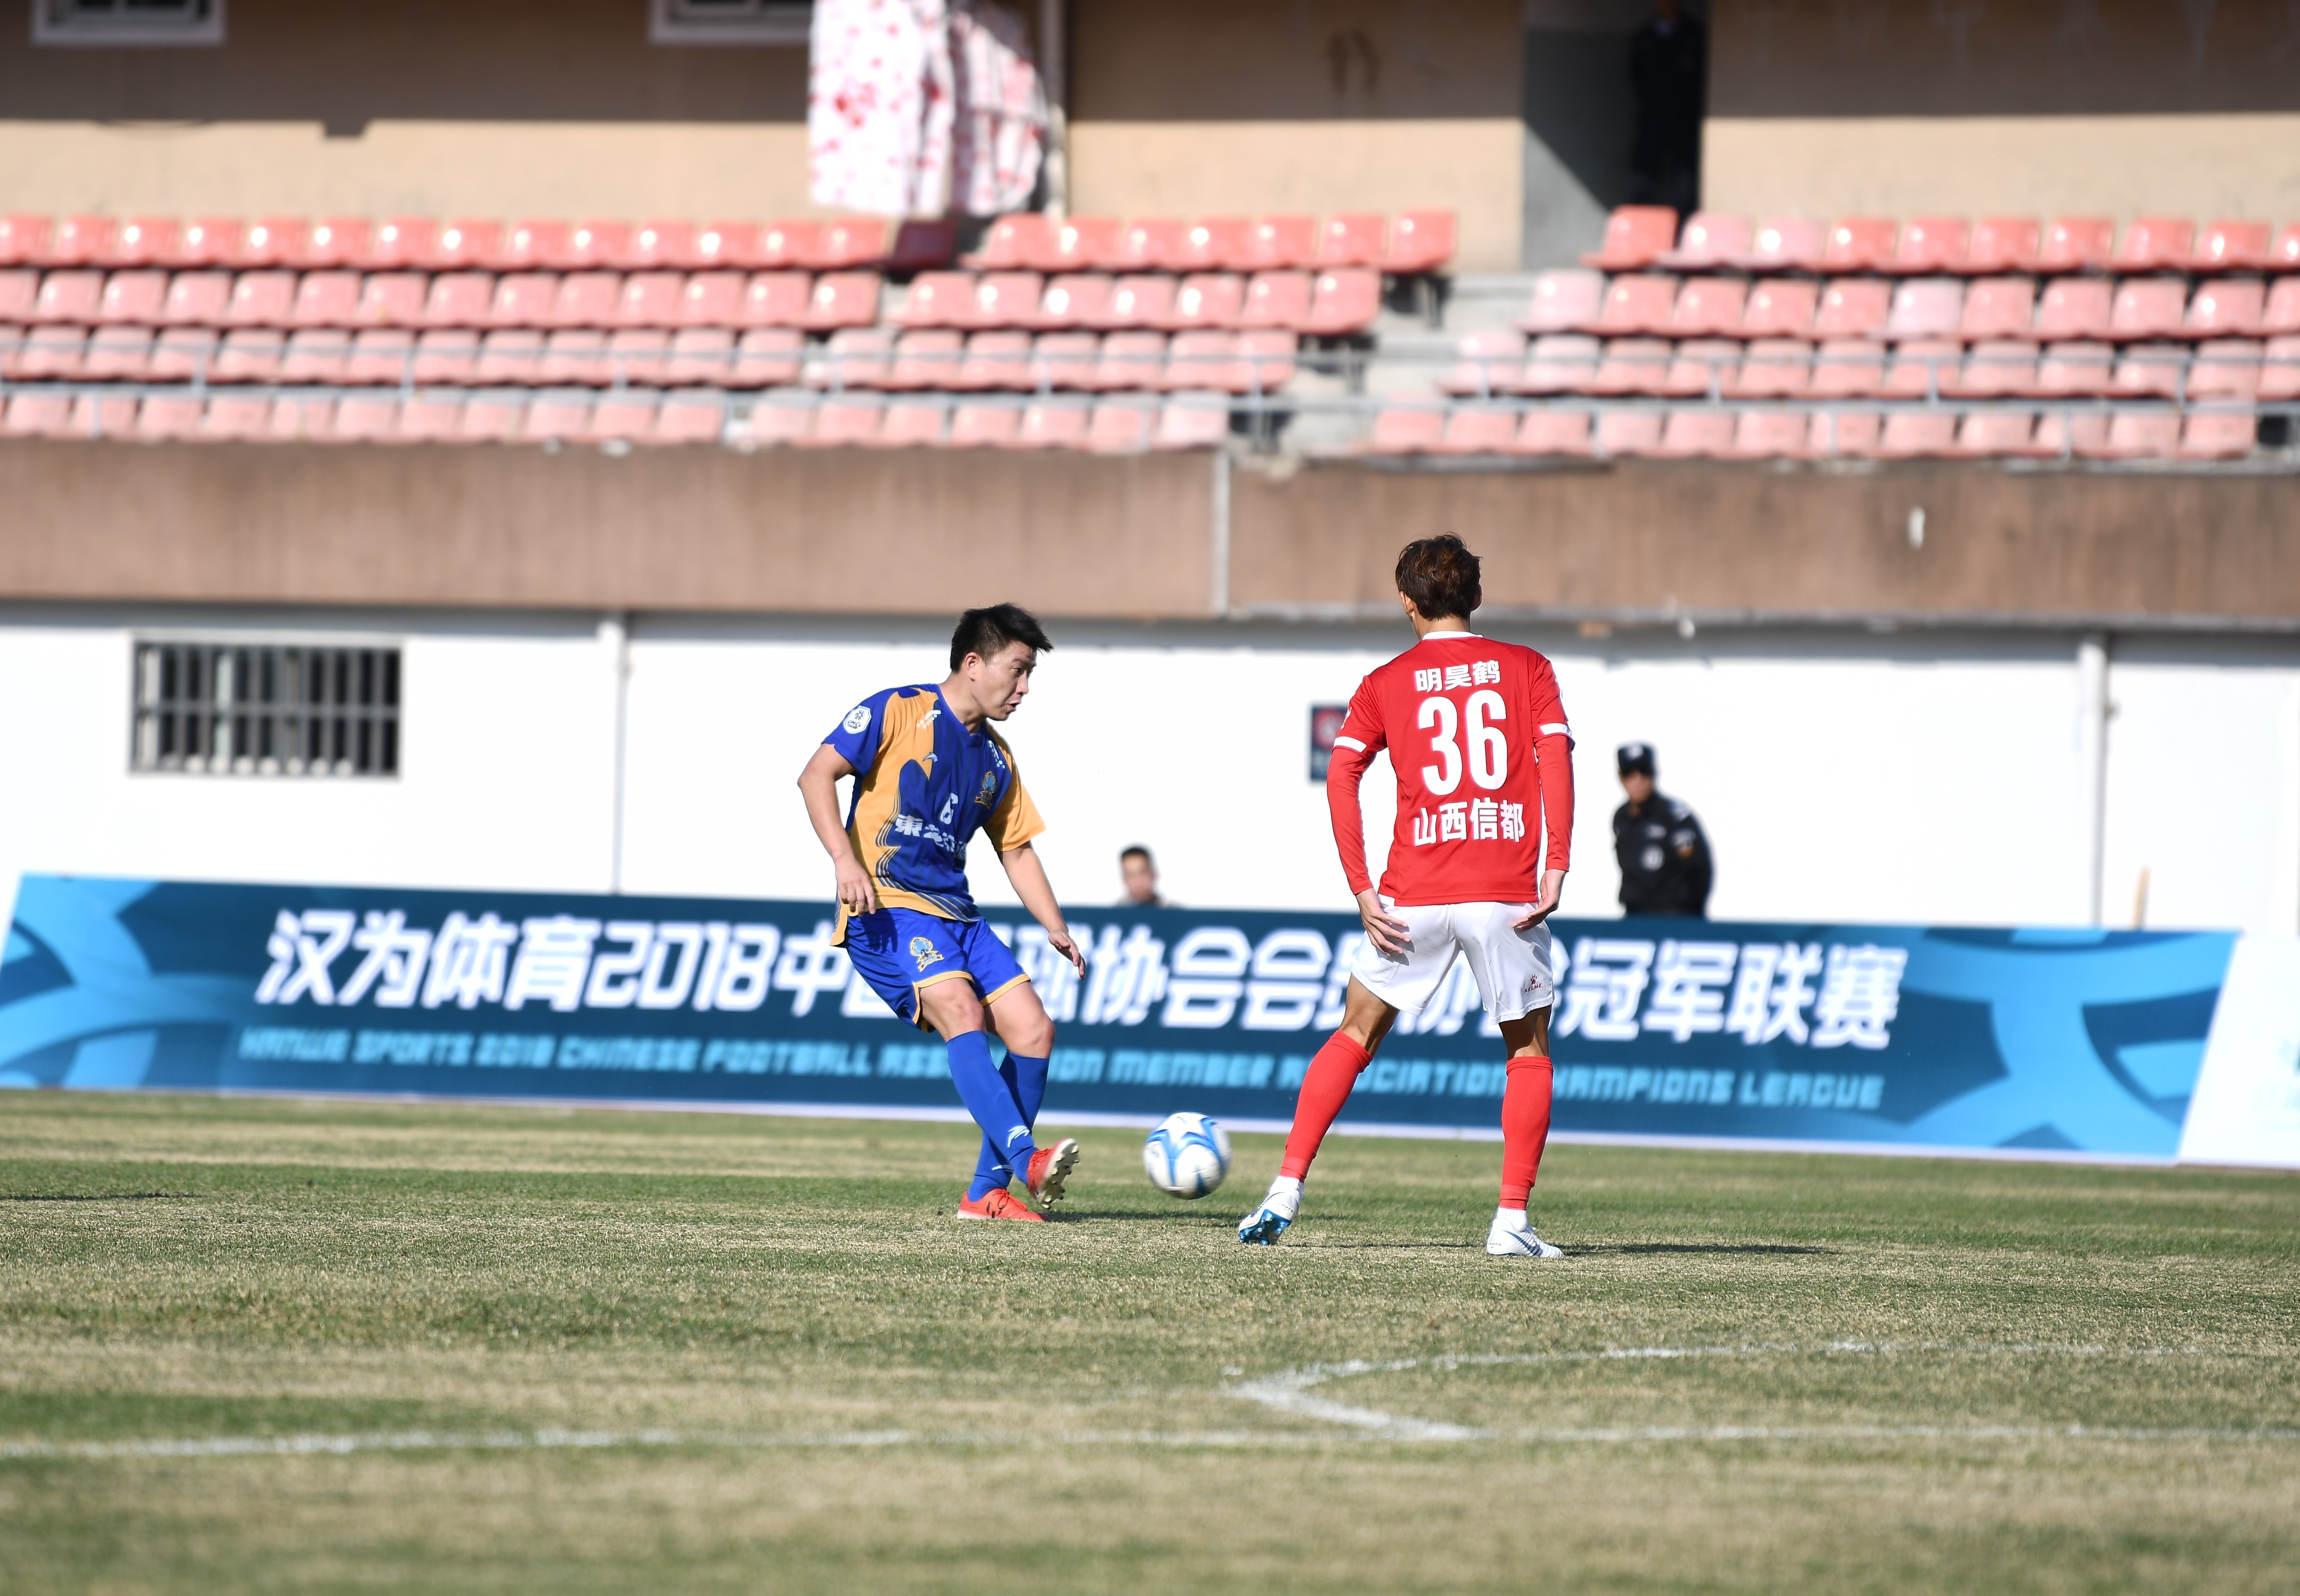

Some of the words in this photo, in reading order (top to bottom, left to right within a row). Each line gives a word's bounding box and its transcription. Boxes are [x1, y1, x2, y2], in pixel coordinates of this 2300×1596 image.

[1415, 659, 1501, 693] 明昊鹤
[1418, 689, 1508, 796] 36
[940, 793, 959, 825] 6
[1414, 797, 1526, 847] 山西信都
[1524, 983, 1543, 994] KELME
[353, 1029, 474, 1066] SPORTS
[474, 1032, 556, 1070] 2018
[556, 1034, 702, 1073] CHINESE
[701, 1039, 873, 1077] FOOTBALL
[1108, 1048, 1276, 1090] MEMBER
[1550, 1064, 1737, 1106] HAMPIONS
[1736, 1070, 1885, 1110] LEAGUE
